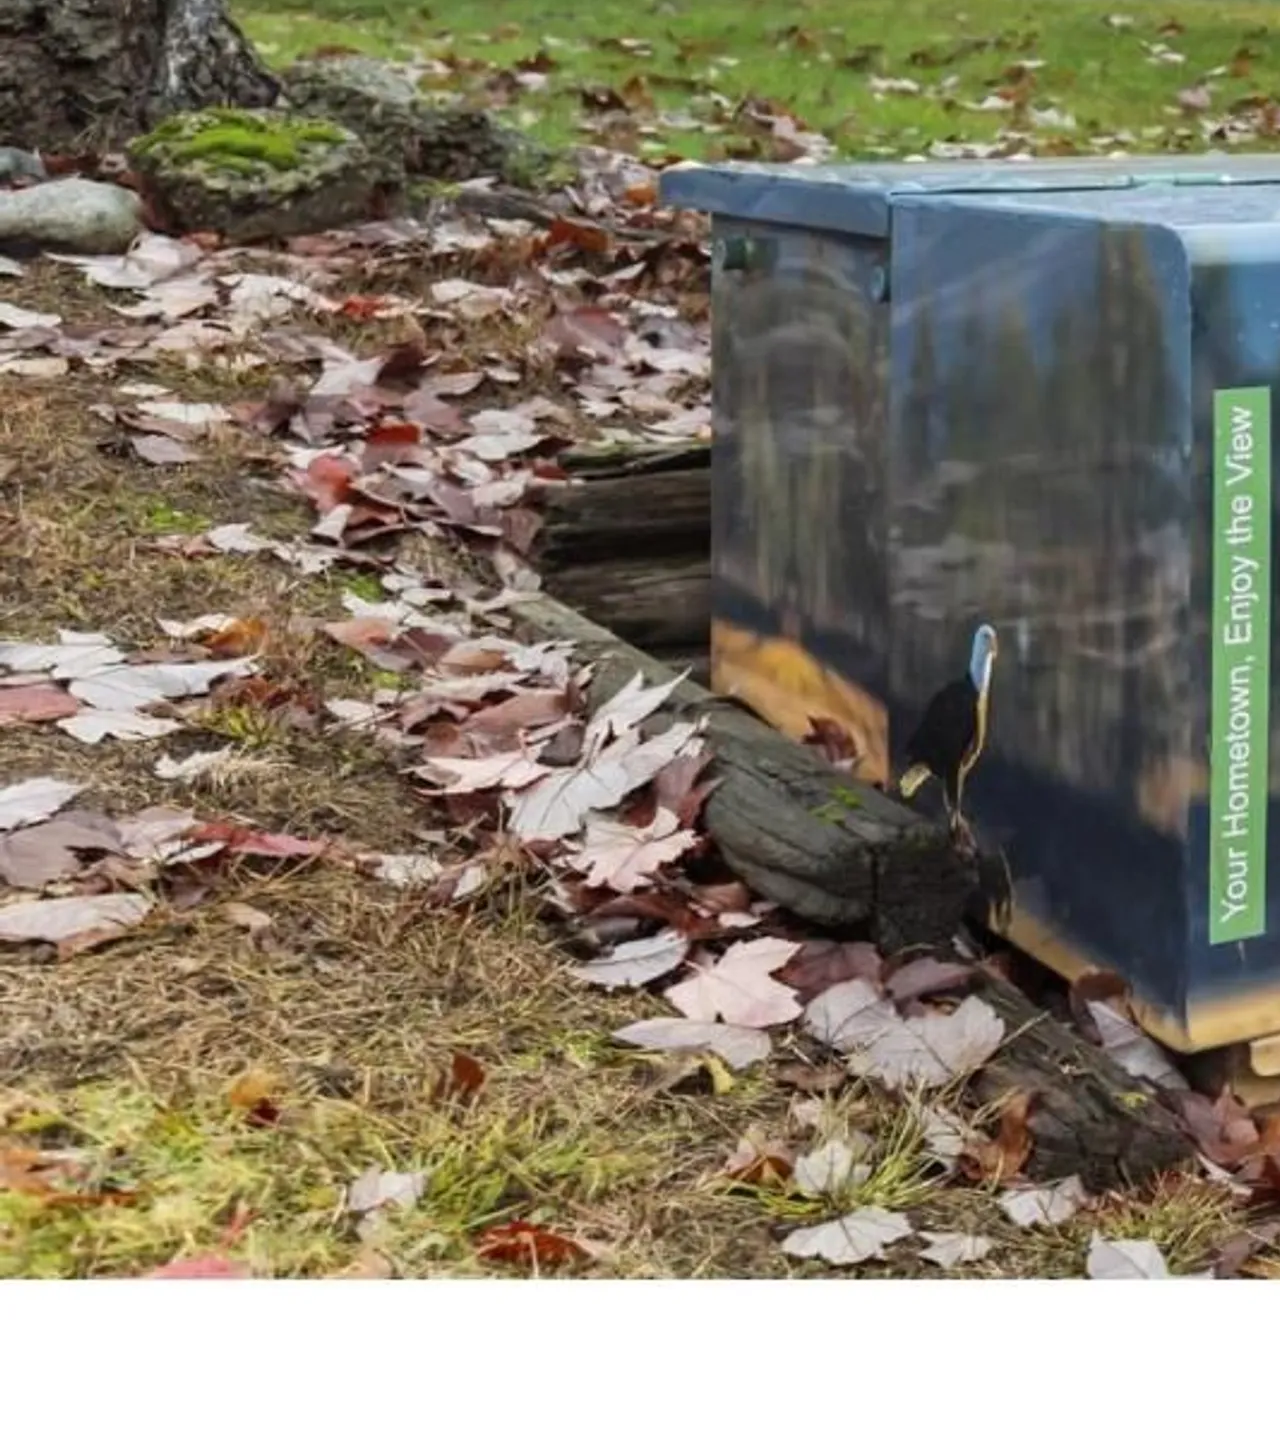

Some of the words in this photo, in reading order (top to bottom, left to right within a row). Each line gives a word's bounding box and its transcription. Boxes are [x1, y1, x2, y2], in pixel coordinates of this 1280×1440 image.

[1225, 405, 1253, 486] View
[1224, 493, 1253, 546] the
[1224, 554, 1260, 645] Enjoy
[1222, 653, 1255, 838] Hometown,
[1219, 846, 1250, 923] Your
